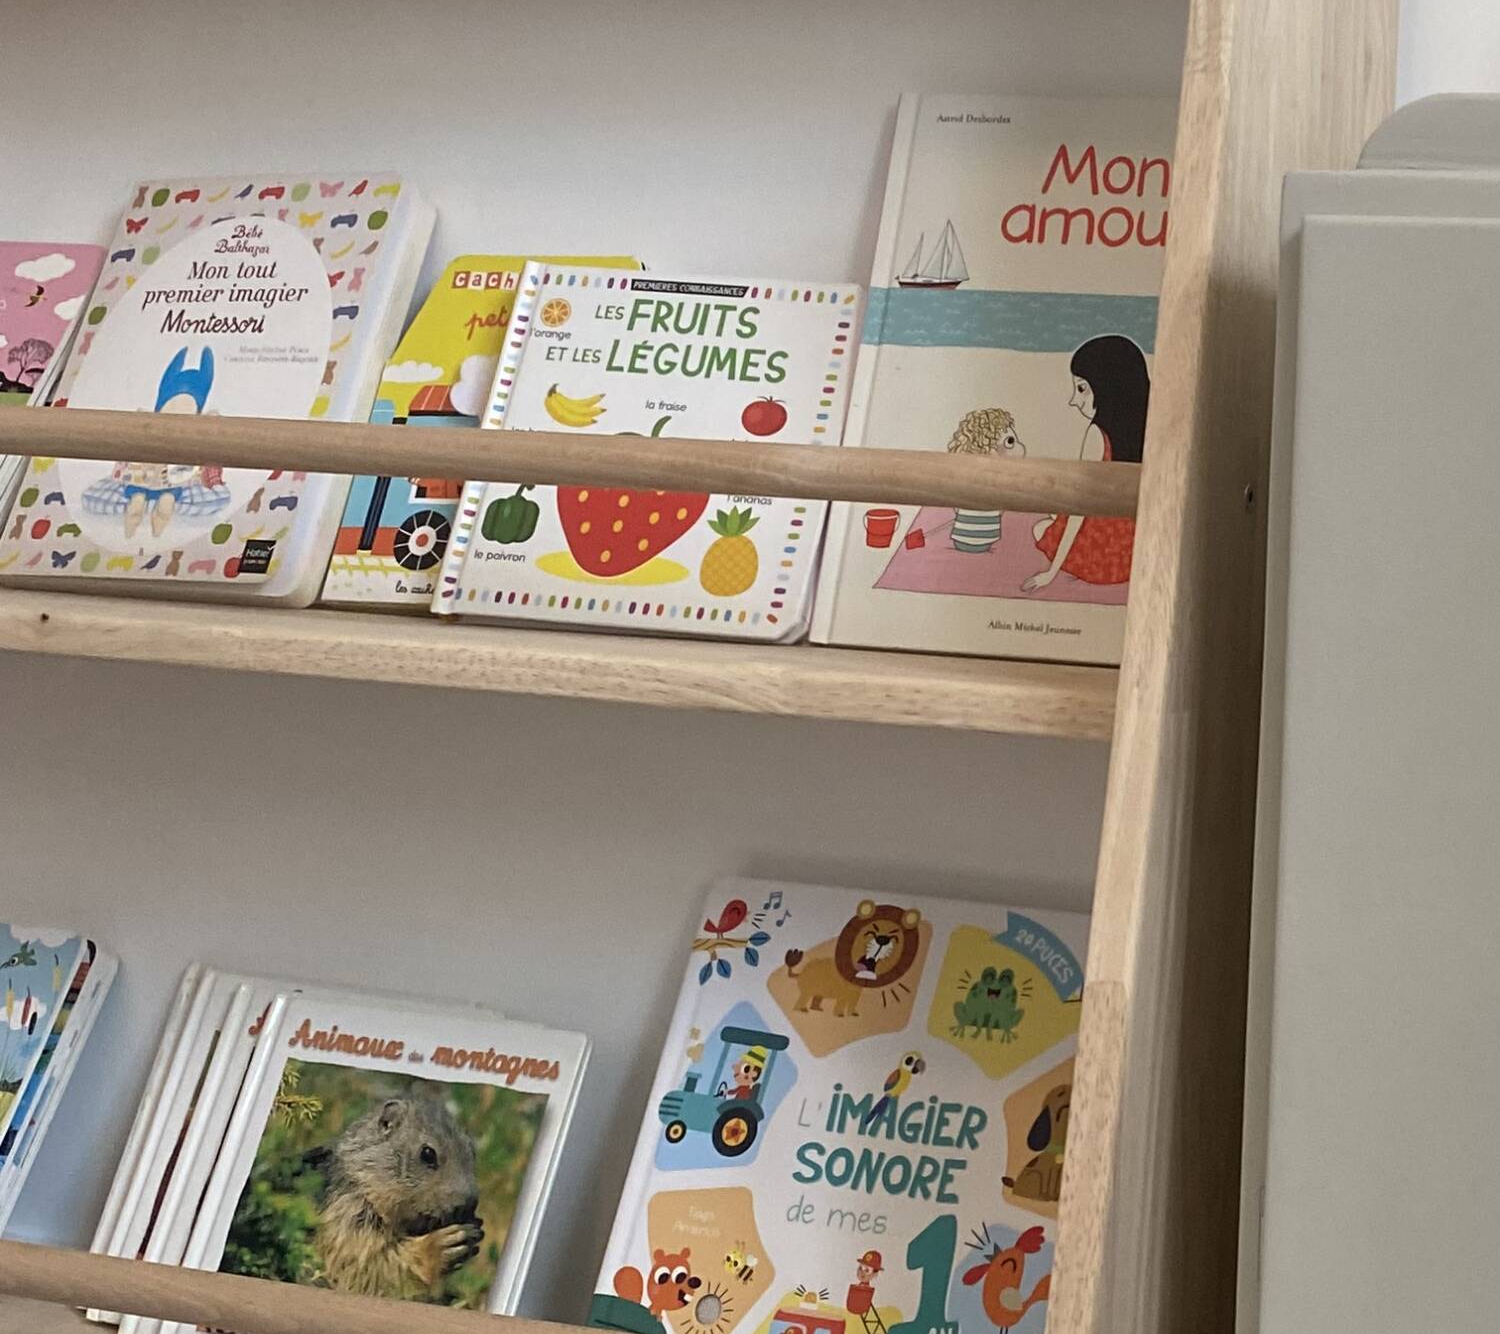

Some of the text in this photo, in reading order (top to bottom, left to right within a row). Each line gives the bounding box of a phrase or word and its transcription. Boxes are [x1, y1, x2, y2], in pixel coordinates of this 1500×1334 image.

[1041, 143, 1170, 197] Mon
[187, 261, 277, 281] Mon tout
[141, 283, 309, 311] premier imagier
[160, 309, 266, 334] Montessori
[595, 298, 761, 339] LES FRUITS
[545, 339, 790, 384] ET LES LÉGUMES
[645, 399, 688, 412] la fraise
[474, 549, 527, 563] le poivron
[1030, 937, 1074, 984] PUCES
[288, 1018, 405, 1060] Animaux
[430, 1045, 561, 1085] montagnes
[792, 1141, 967, 1204] SONORE
[786, 1195, 888, 1235] de mes
